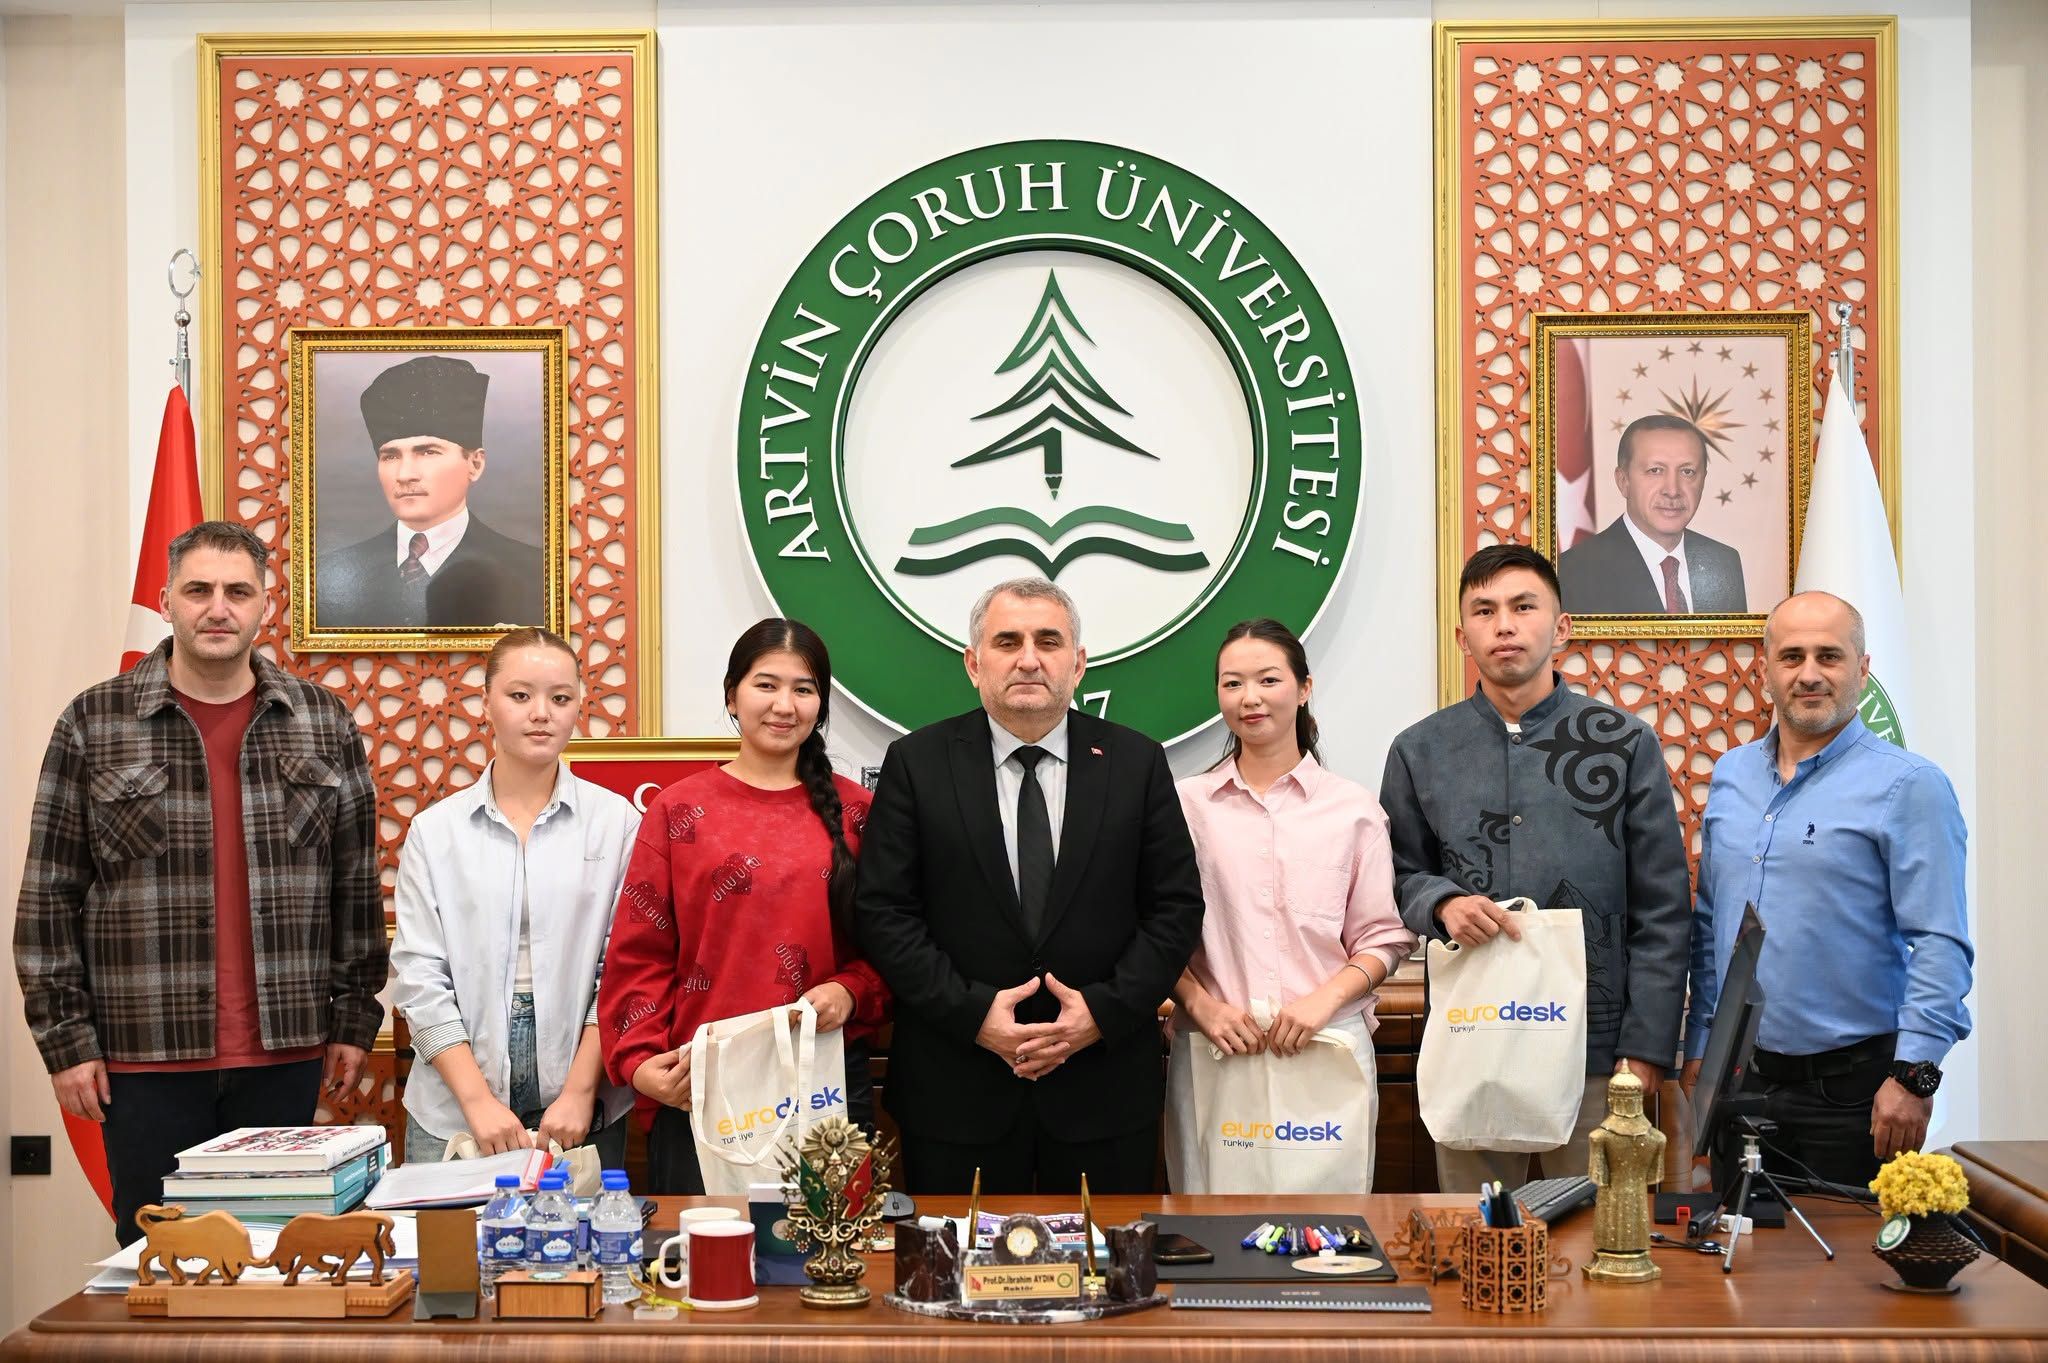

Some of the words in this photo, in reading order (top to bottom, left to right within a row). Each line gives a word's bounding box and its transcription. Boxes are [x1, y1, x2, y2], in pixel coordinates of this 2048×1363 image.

[760, 303, 841, 562] ARTVİN
[828, 161, 1069, 304] ÇORUH
[1095, 160, 1346, 568] ÜNİVERSİTESİ
[1447, 1000, 1567, 1025] eurodesk
[1221, 1120, 1343, 1142] eurodesk
[1033, 1274, 1055, 1283] AYDIN
